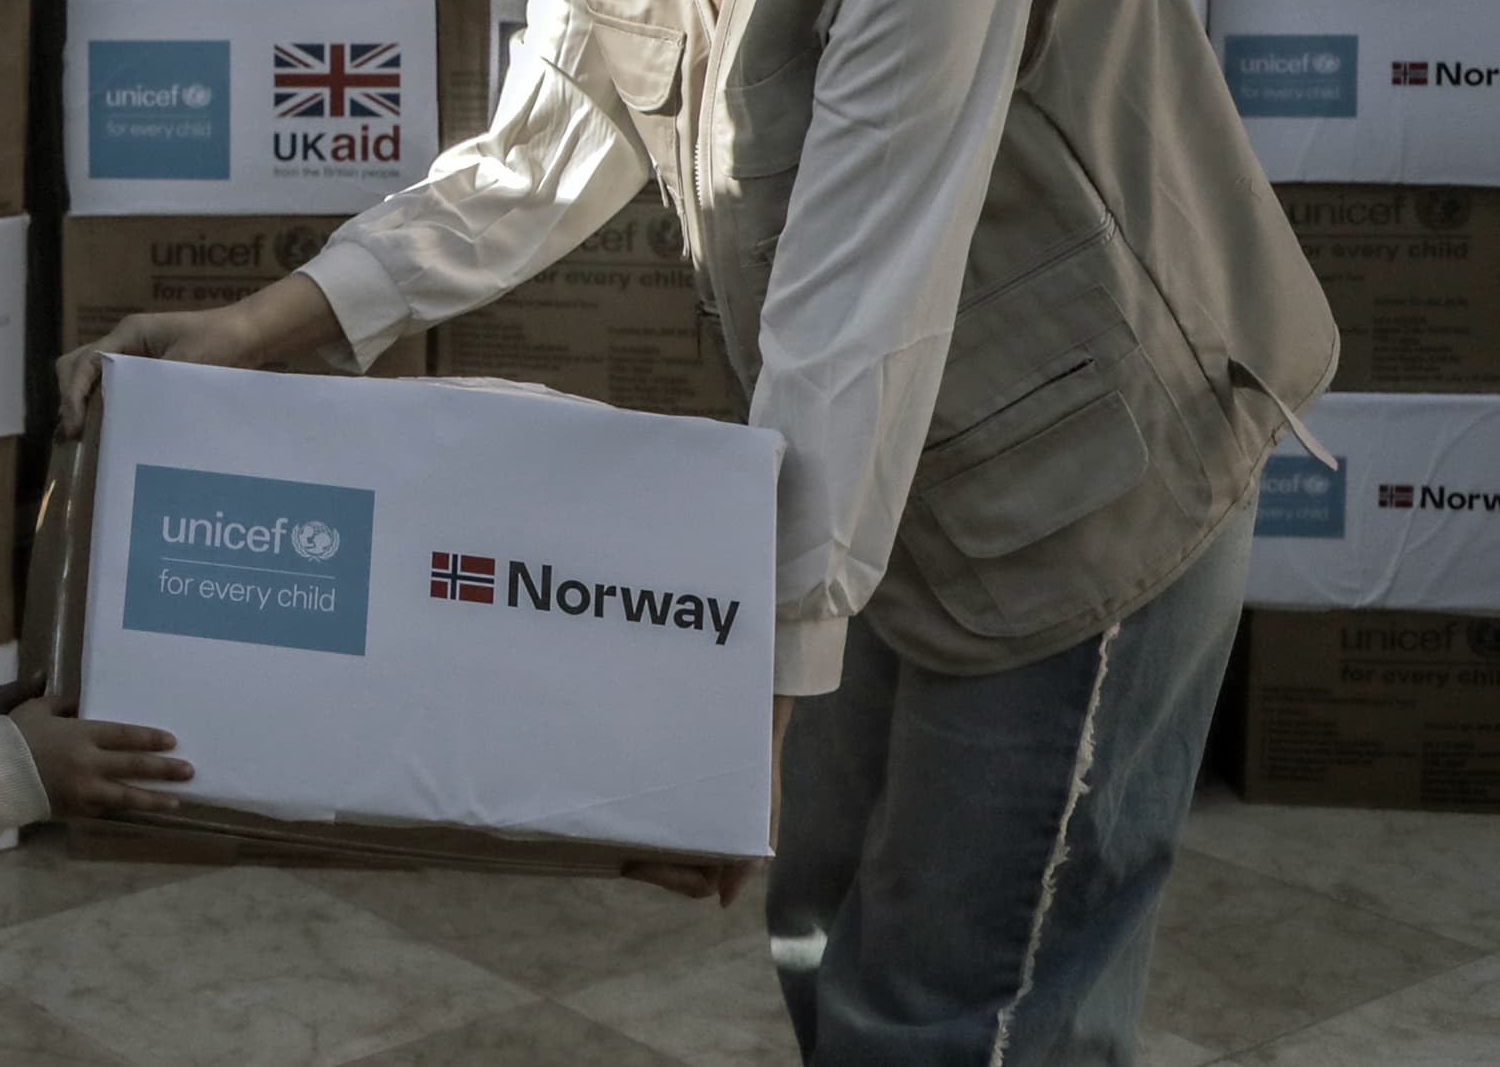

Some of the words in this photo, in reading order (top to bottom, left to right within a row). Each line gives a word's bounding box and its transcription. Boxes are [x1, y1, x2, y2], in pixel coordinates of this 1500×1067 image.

[1241, 55, 1309, 74] unicef
[1436, 62, 1499, 86] Nor
[106, 85, 179, 108] unicef
[273, 122, 400, 162] UKaid
[1290, 195, 1408, 227] unicef
[150, 235, 265, 269] unicef
[1332, 244, 1400, 261] every
[1408, 241, 1468, 260] child
[152, 281, 185, 302] for
[565, 269, 632, 291] every
[161, 511, 288, 555] unicef
[158, 567, 194, 597] for
[199, 575, 272, 614] every
[277, 580, 336, 613] child
[507, 559, 741, 646] Norway
[1340, 620, 1461, 652] unicef
[1341, 666, 1375, 683] for
[1382, 668, 1449, 688] every
